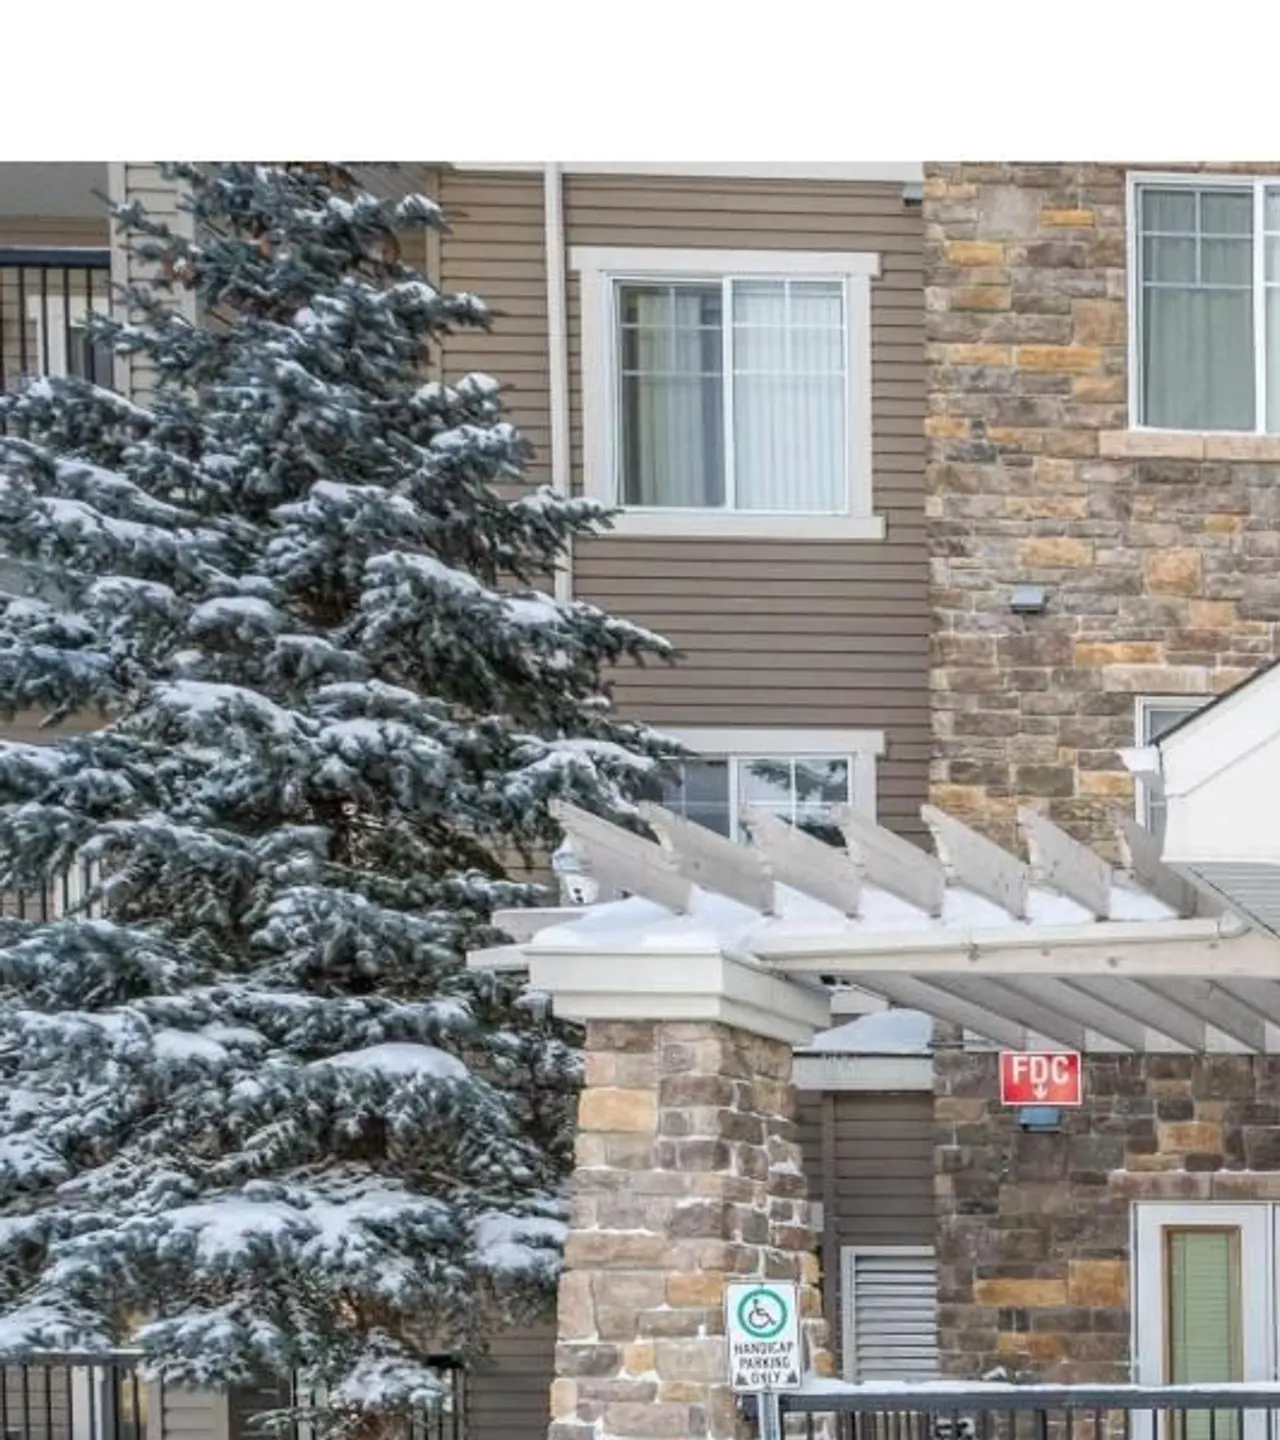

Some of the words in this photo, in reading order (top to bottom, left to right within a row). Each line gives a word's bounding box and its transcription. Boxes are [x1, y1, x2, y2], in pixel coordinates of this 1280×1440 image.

[1012, 1055, 1069, 1085] FDC
[739, 1357, 791, 1369] PARKING
[751, 1372, 781, 1384] ONLY
